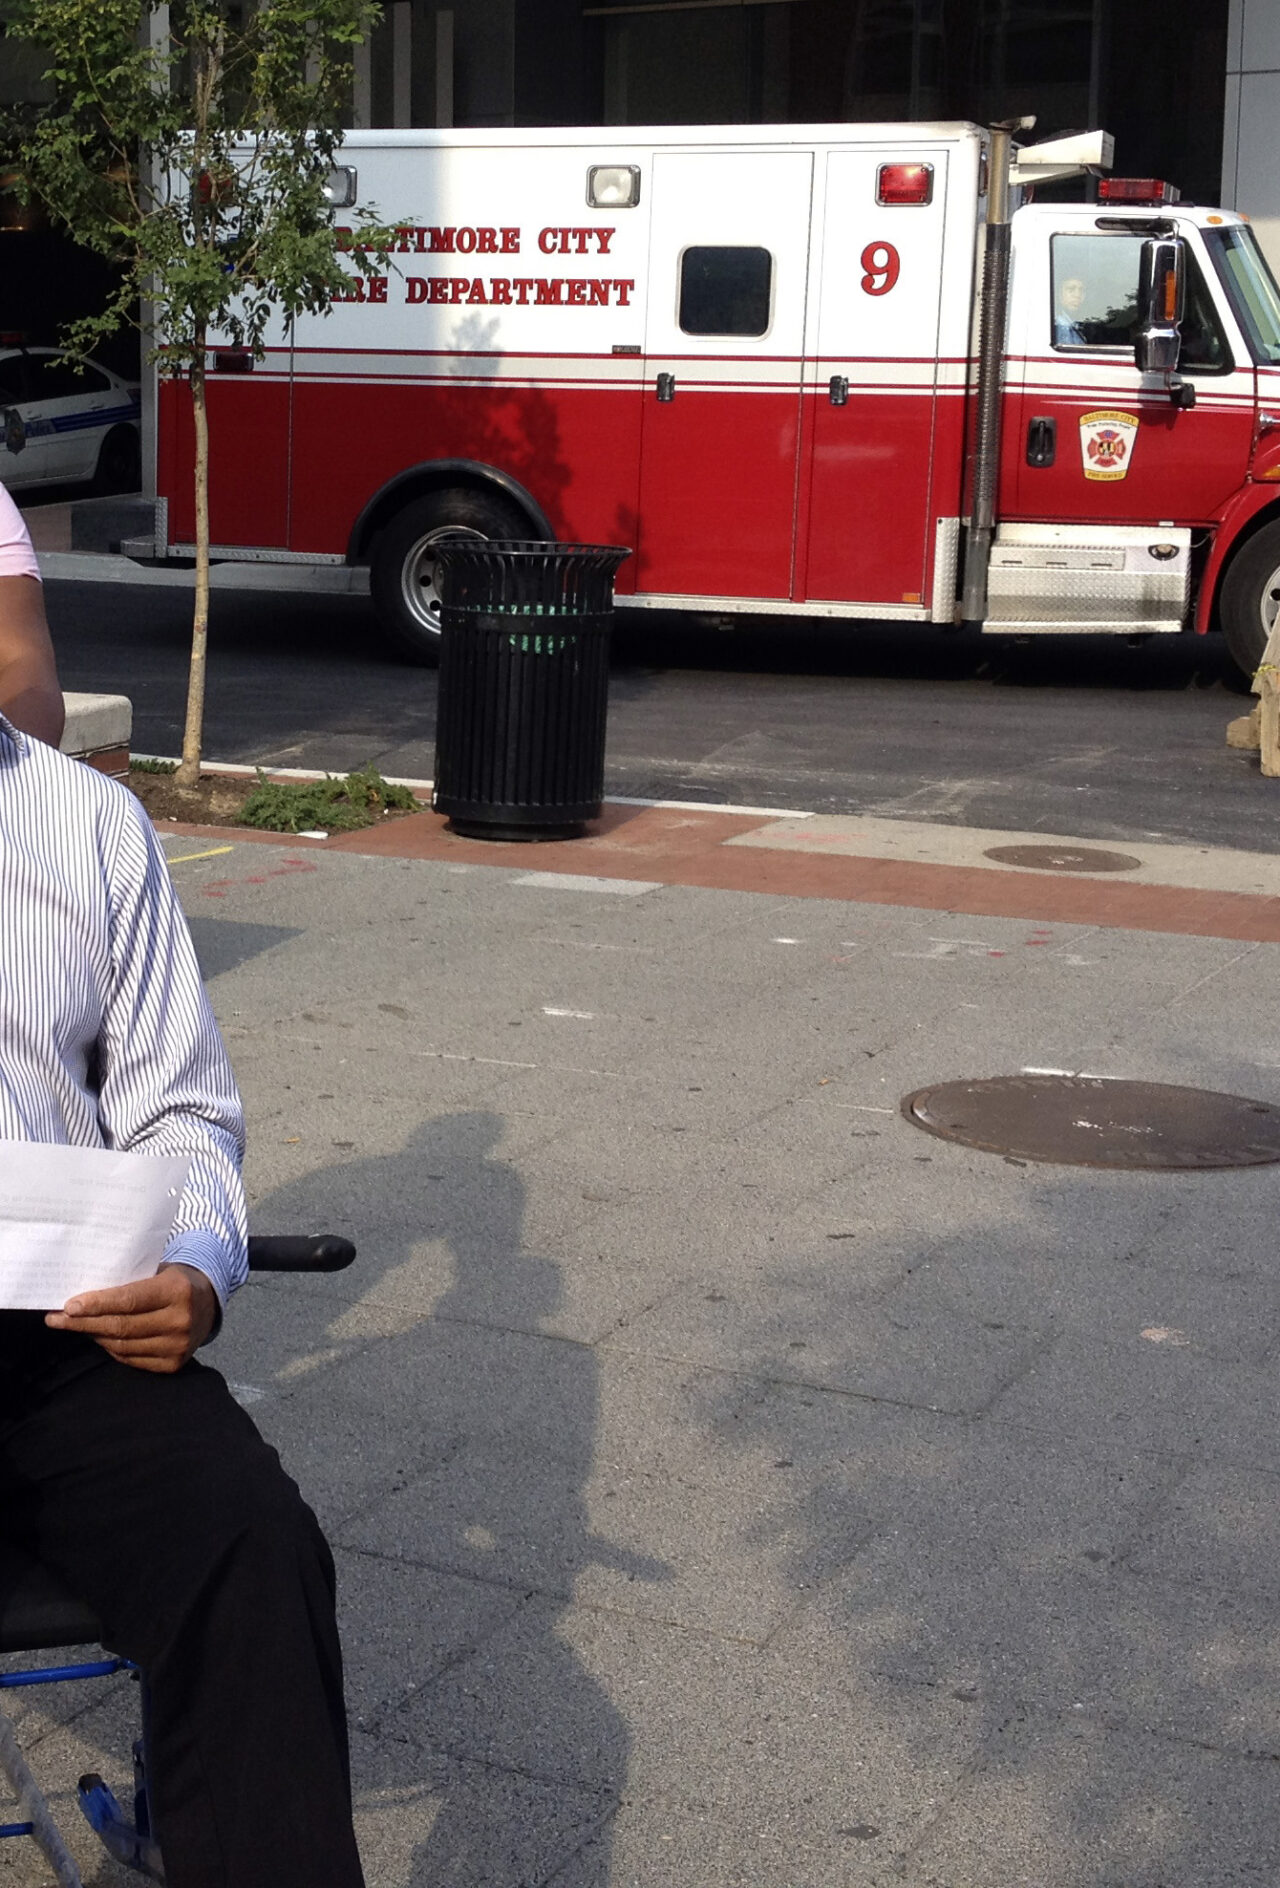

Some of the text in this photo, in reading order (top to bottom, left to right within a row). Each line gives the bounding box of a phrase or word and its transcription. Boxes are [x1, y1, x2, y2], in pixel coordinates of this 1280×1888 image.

[333, 225, 616, 254] BTIMORE CITY
[860, 240, 901, 297] 9
[326, 276, 635, 307] RE DEPARTMENT
